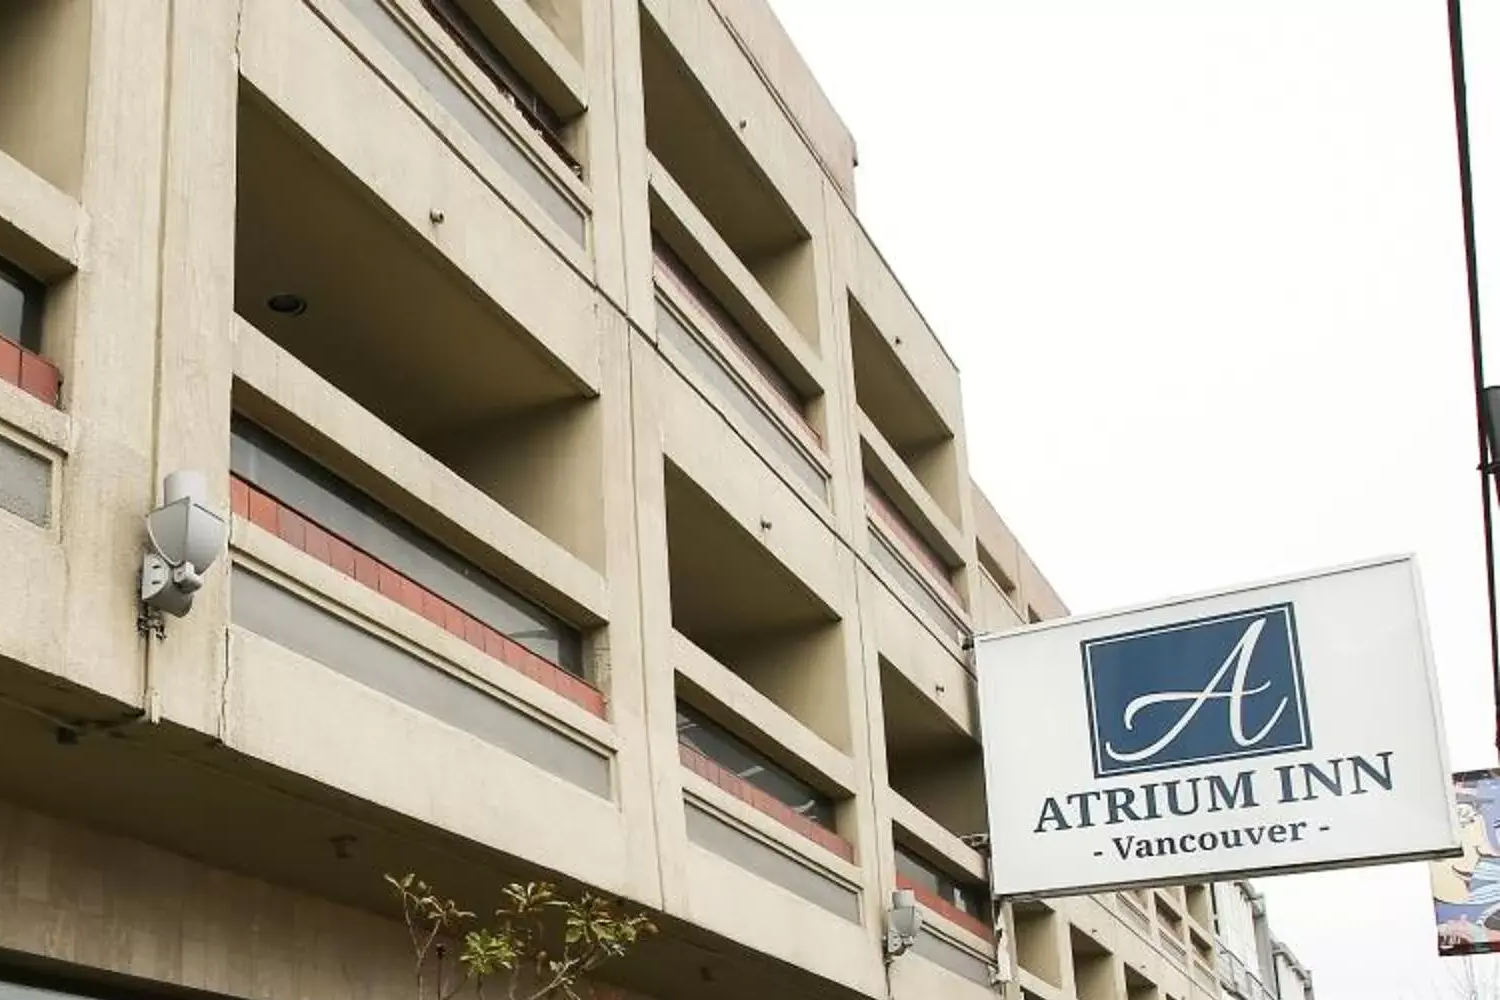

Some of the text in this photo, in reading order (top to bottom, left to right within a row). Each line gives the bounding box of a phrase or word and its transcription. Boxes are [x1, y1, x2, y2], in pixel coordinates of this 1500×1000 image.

[1033, 751, 1394, 834] ATRIUM INN
[1111, 820, 1308, 862] Vancouver
